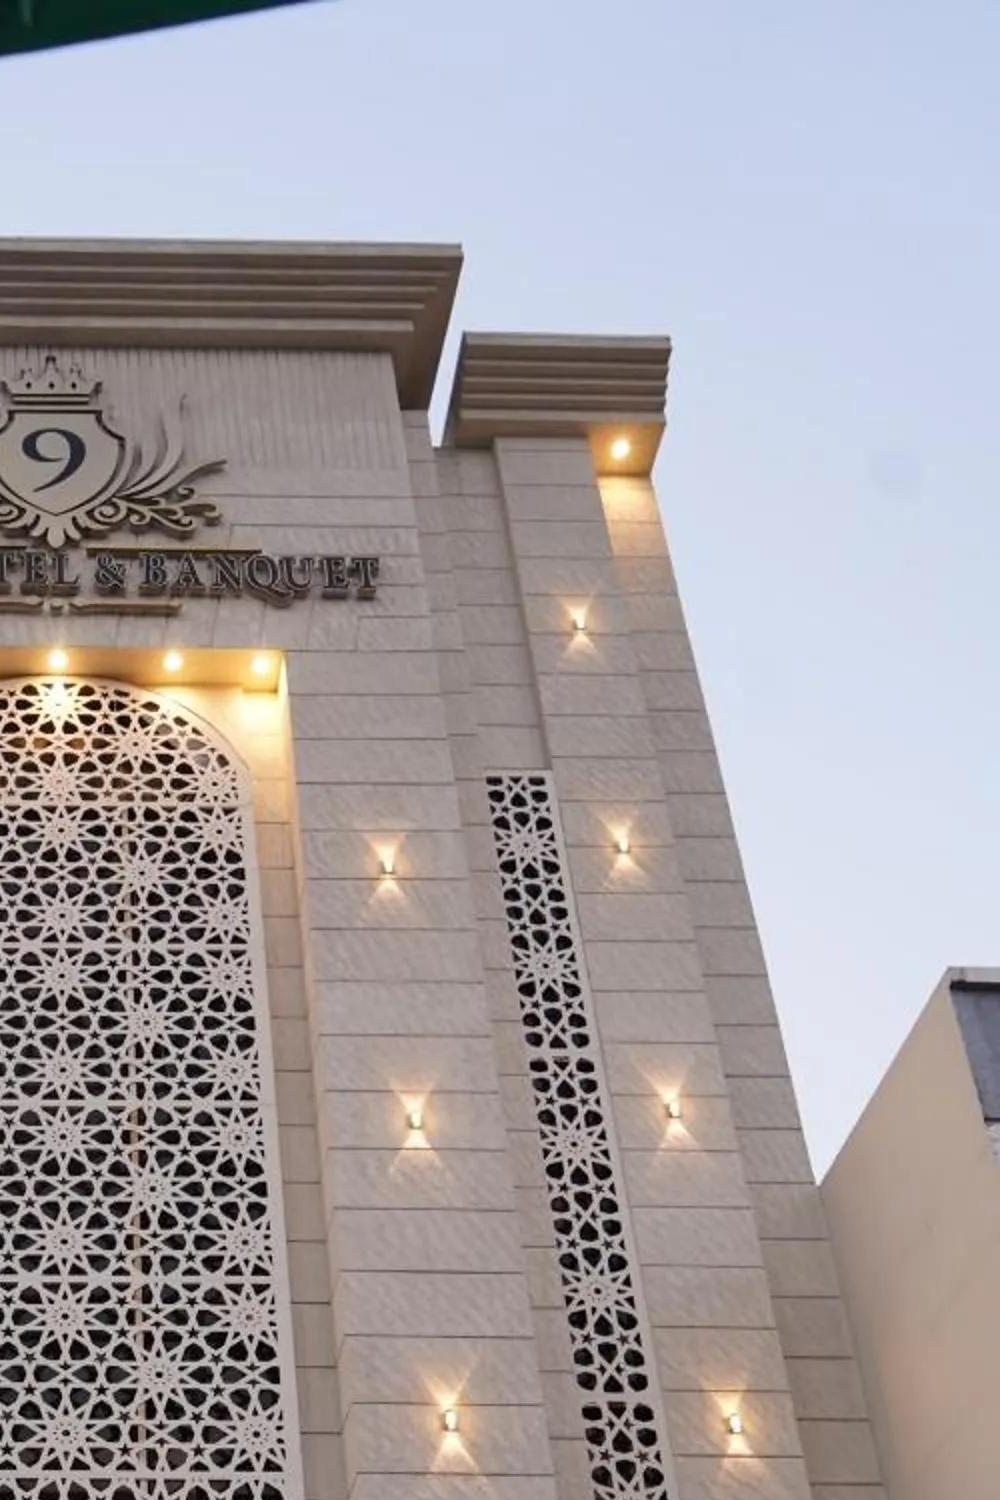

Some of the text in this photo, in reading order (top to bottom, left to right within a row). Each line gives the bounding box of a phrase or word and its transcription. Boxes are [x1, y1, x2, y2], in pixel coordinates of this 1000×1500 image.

[21, 427, 87, 493] 9
[94, 553, 127, 591] &
[139, 552, 379, 604] BANQUET
